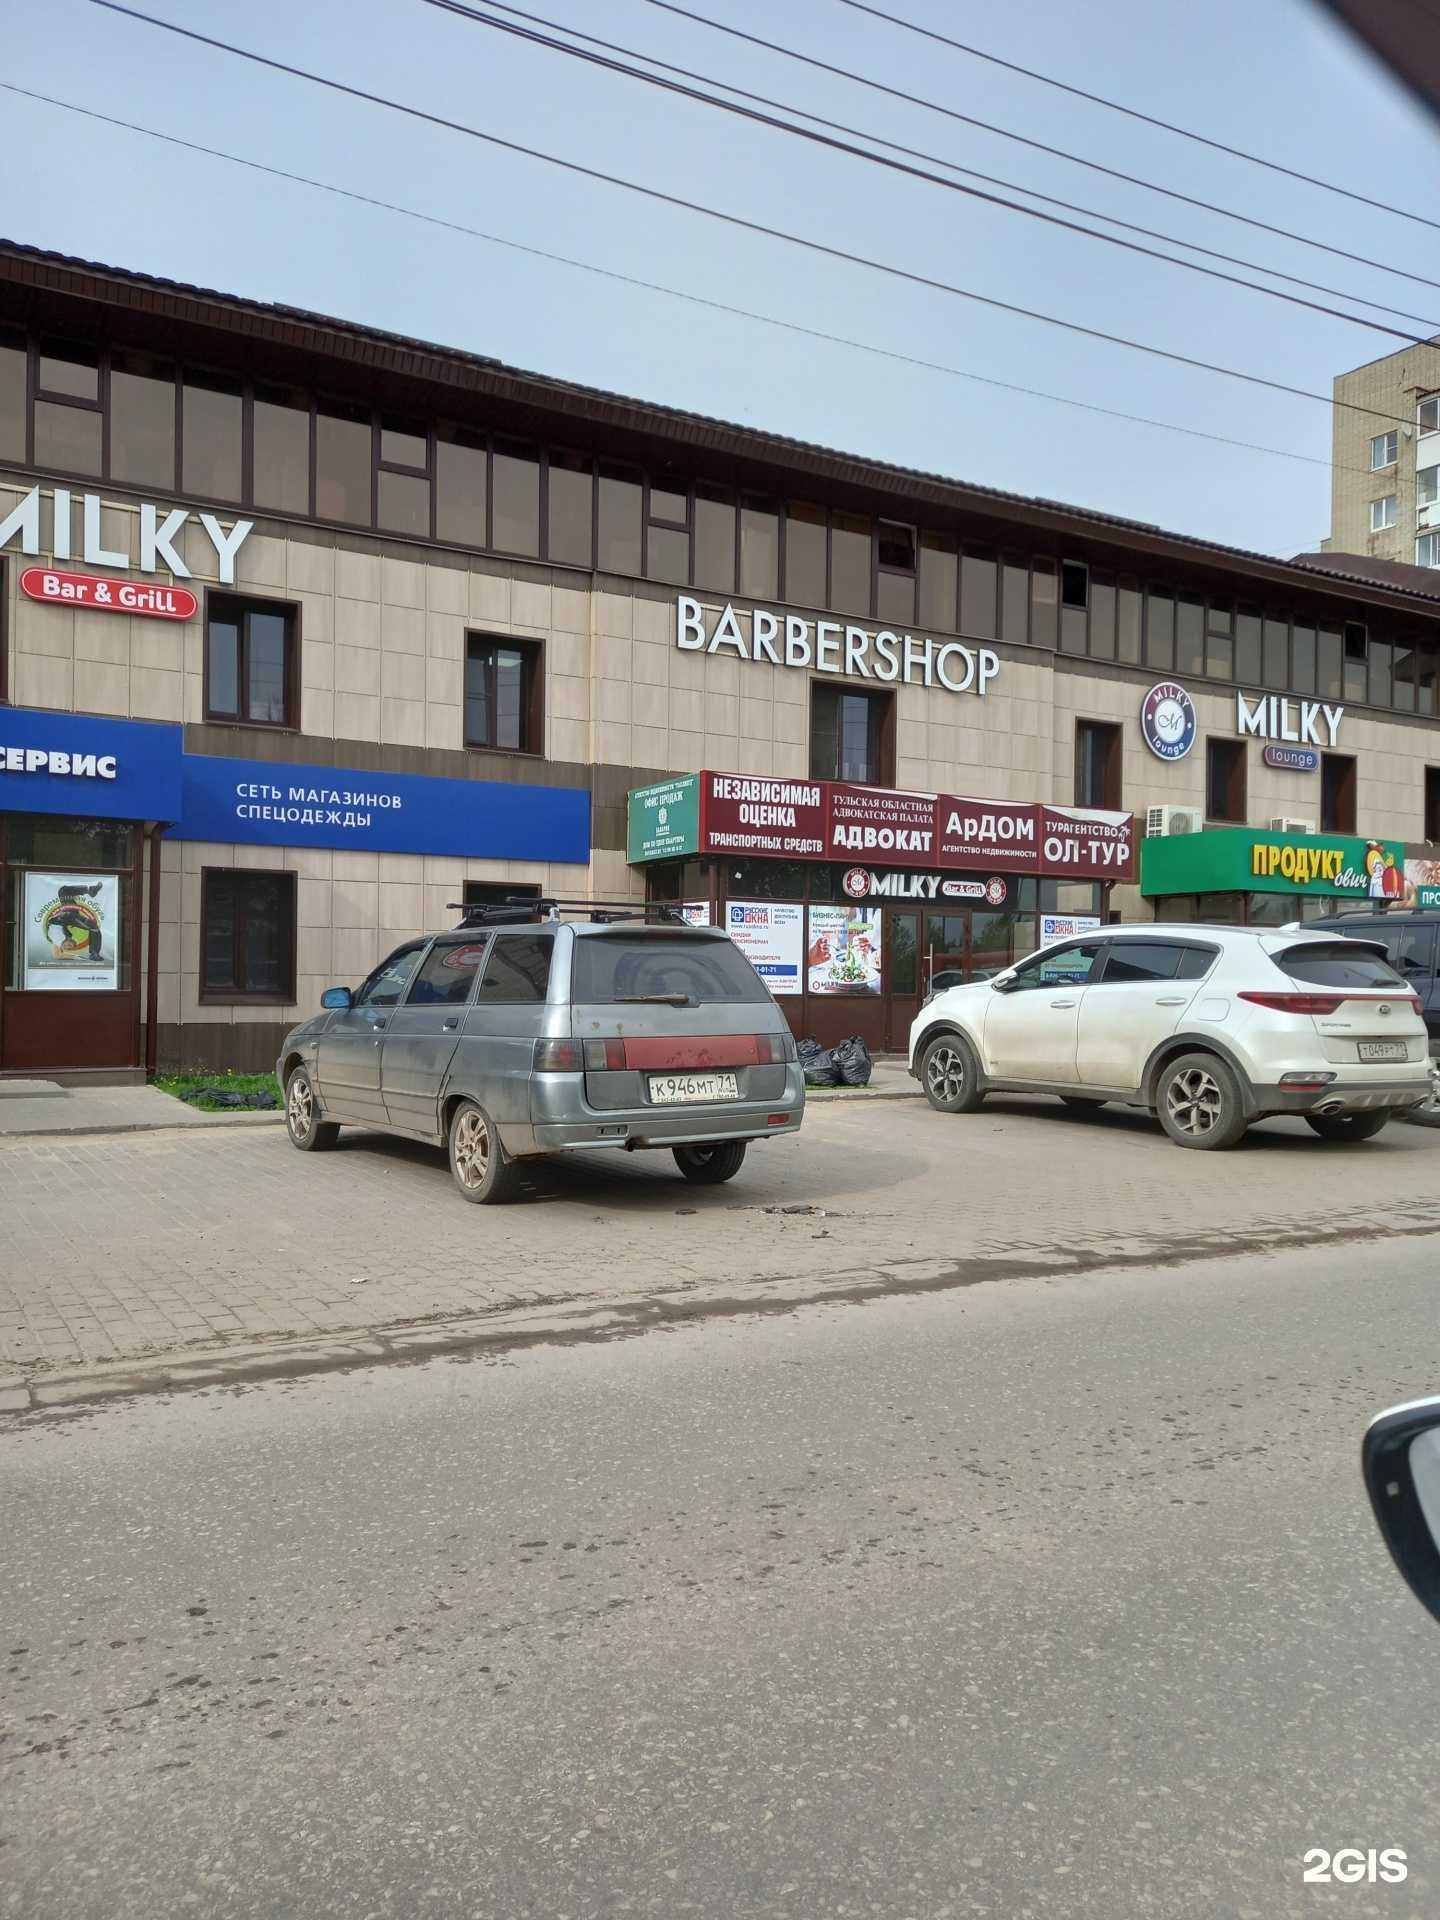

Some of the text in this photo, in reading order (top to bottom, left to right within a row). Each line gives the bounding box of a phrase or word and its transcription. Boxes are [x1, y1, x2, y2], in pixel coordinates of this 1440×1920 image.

[43, 575, 177, 613] Bar & Grill
[677, 595, 1000, 695] BARBERSHOP
[1153, 687, 1190, 708] MILKY
[1237, 689, 1344, 747] MILKY
[1152, 735, 1185, 757] lounge
[1272, 749, 1313, 767] lounge
[0, 746, 116, 778] ЕРВИС
[236, 783, 402, 809] СЕТЬ МАГАЗИНОВ
[713, 778, 820, 807] НЕЗАВИСИМАЯ
[833, 795, 933, 813] ТУЛЬСКАЯ ОБЛАСТНАЯ
[236, 804, 371, 828] СПЕЦОДЕЖДЫ
[739, 803, 796, 828] ОЦЕНКА
[833, 808, 933, 824] АДВОКАТСКАЯ ПАЛАТА
[945, 812, 1034, 842] АрДОМ
[833, 824, 933, 851] АДВОКАТ
[1046, 821, 1118, 838] ТУРАГЕНТСТВО
[709, 832, 823, 853] ТРАНСПОРТНЫХ СРЕДСТВ
[942, 845, 1037, 859] АГЕНТСТВО НЕДВИЖИМОСТИ
[870, 872, 941, 899] MILKY
[745, 912, 769, 924] ОКНА
